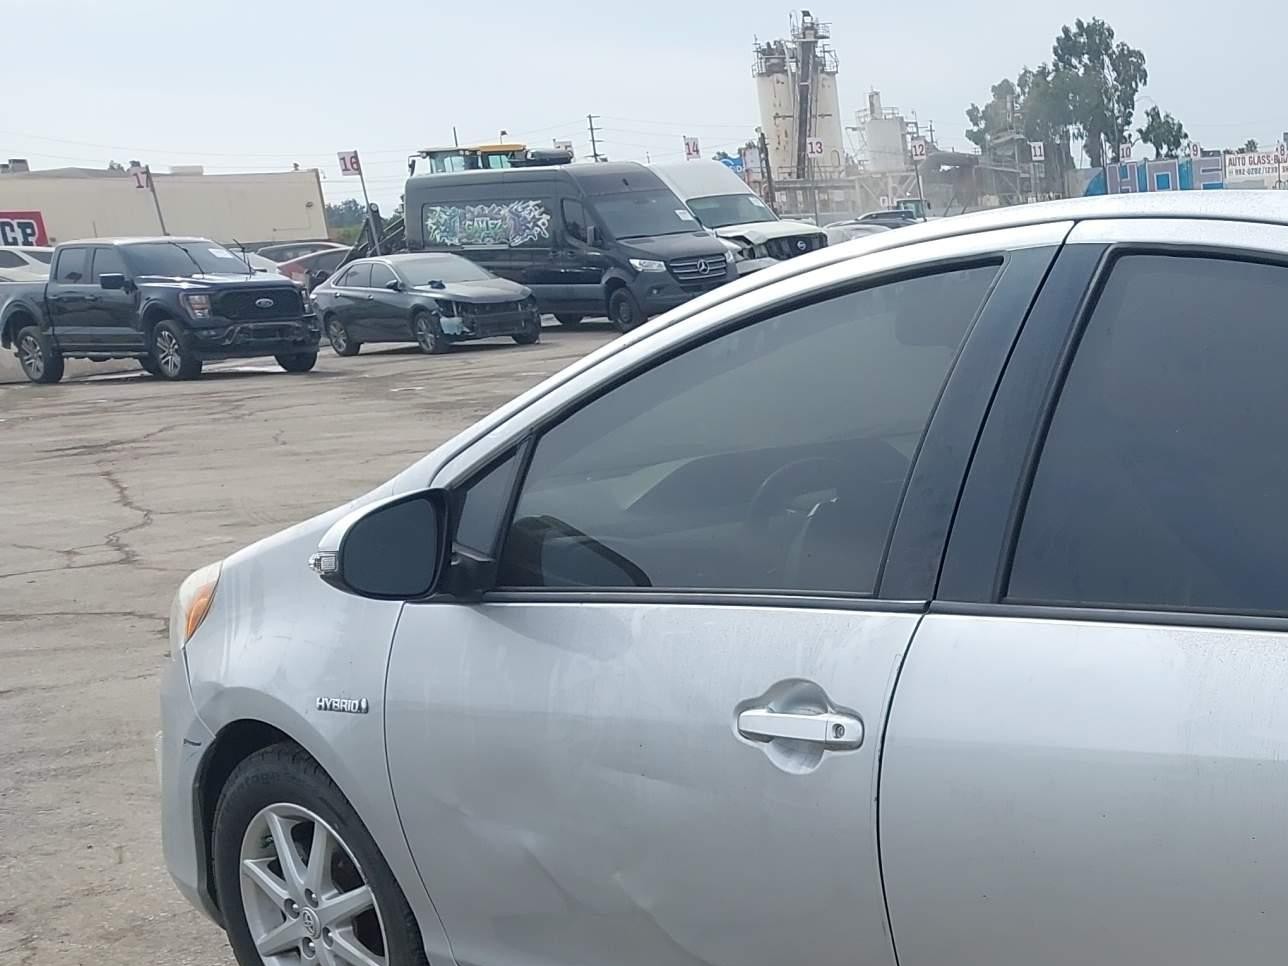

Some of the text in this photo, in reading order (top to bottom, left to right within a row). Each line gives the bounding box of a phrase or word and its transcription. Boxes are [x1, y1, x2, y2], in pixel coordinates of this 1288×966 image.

[685, 142, 700, 156] 14
[808, 142, 823, 155] 13
[912, 144, 926, 157] 12
[1031, 145, 1045, 157] 11
[1120, 146, 1131, 158] 10
[1192, 144, 1199, 157] 9
[1280, 144, 1286, 156] 8
[340, 155, 360, 172] 16
[1228, 156, 1246, 167] AUTO
[316, 697, 360, 712] HYBRID
